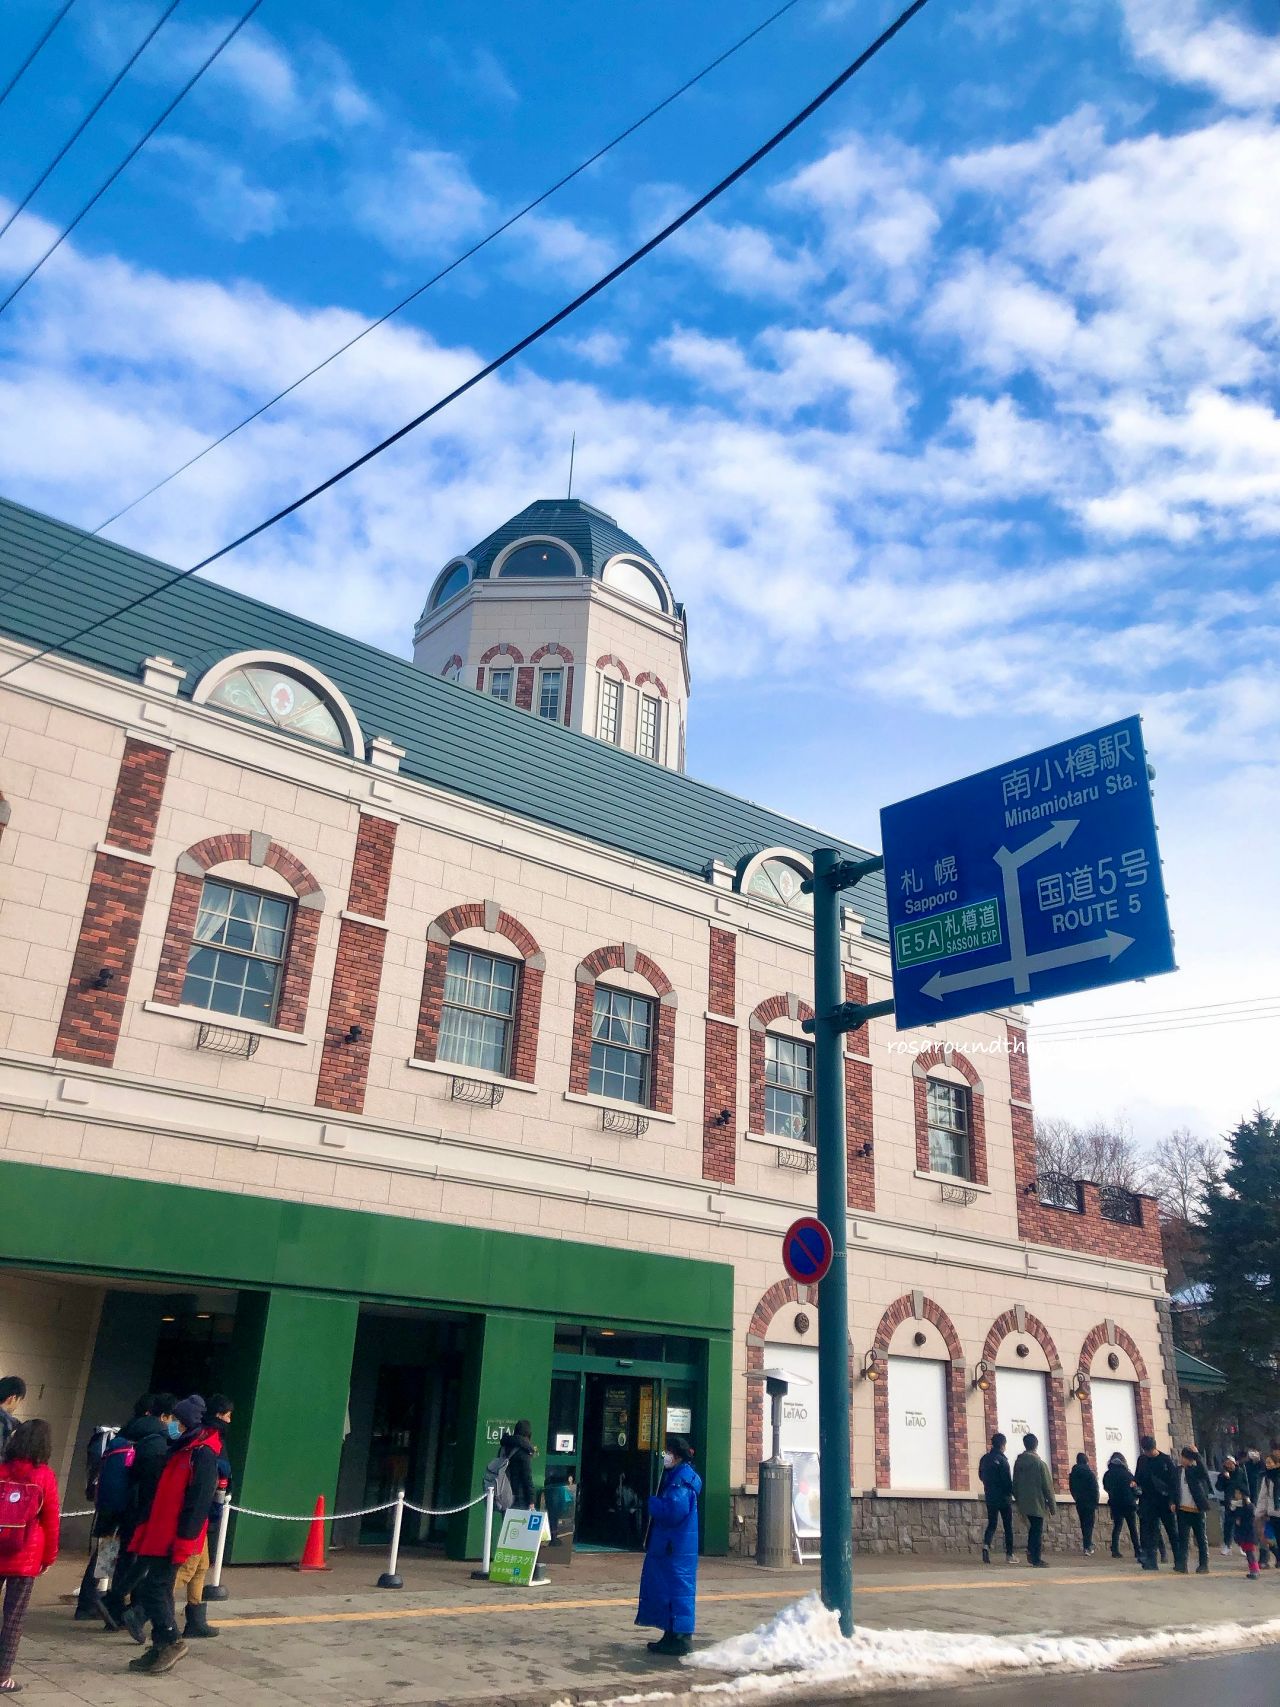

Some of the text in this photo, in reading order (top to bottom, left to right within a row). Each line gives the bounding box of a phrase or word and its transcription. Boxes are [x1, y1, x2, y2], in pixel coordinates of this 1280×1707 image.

[1000, 729, 1135, 806] 南小樽駅
[1005, 773, 1138, 828] Minamiotaru Sta.
[1036, 848, 1150, 911] 国道5号
[905, 890, 958, 914] Sapporo
[1052, 893, 1142, 934] ROUTE 5
[944, 904, 996, 938] 札樽道
[901, 928, 940, 956] E5A
[946, 929, 998, 954] SASSON EXP
